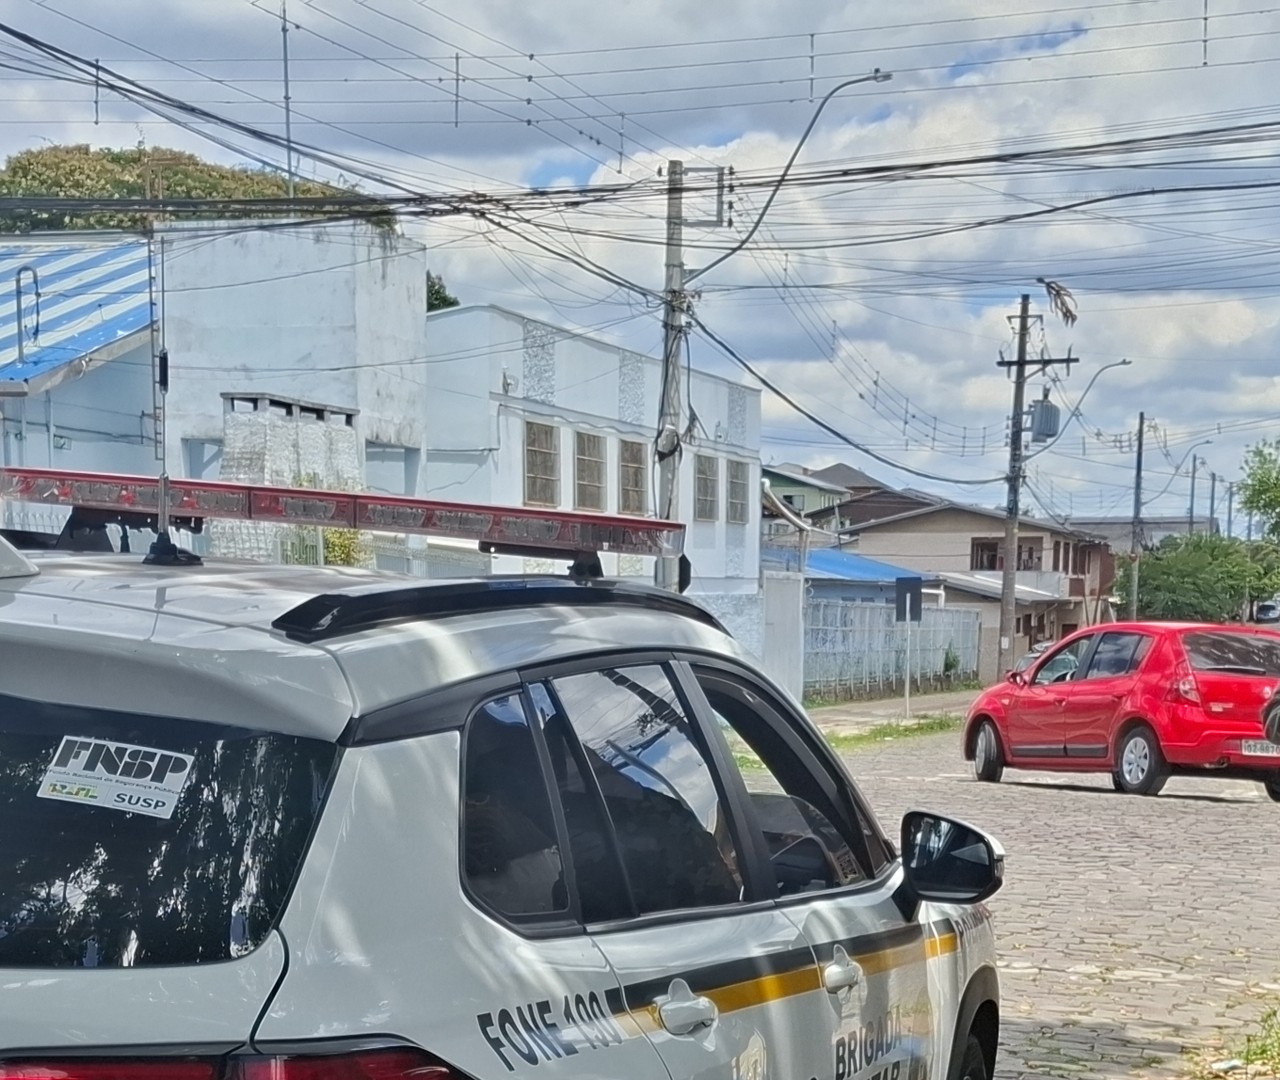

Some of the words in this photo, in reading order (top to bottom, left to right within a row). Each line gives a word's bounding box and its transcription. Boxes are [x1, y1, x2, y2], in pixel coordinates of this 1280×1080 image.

[53, 738, 189, 785] FNSP
[113, 792, 167, 810] SUSP
[477, 999, 579, 1072] FONE
[563, 990, 623, 1050] 190
